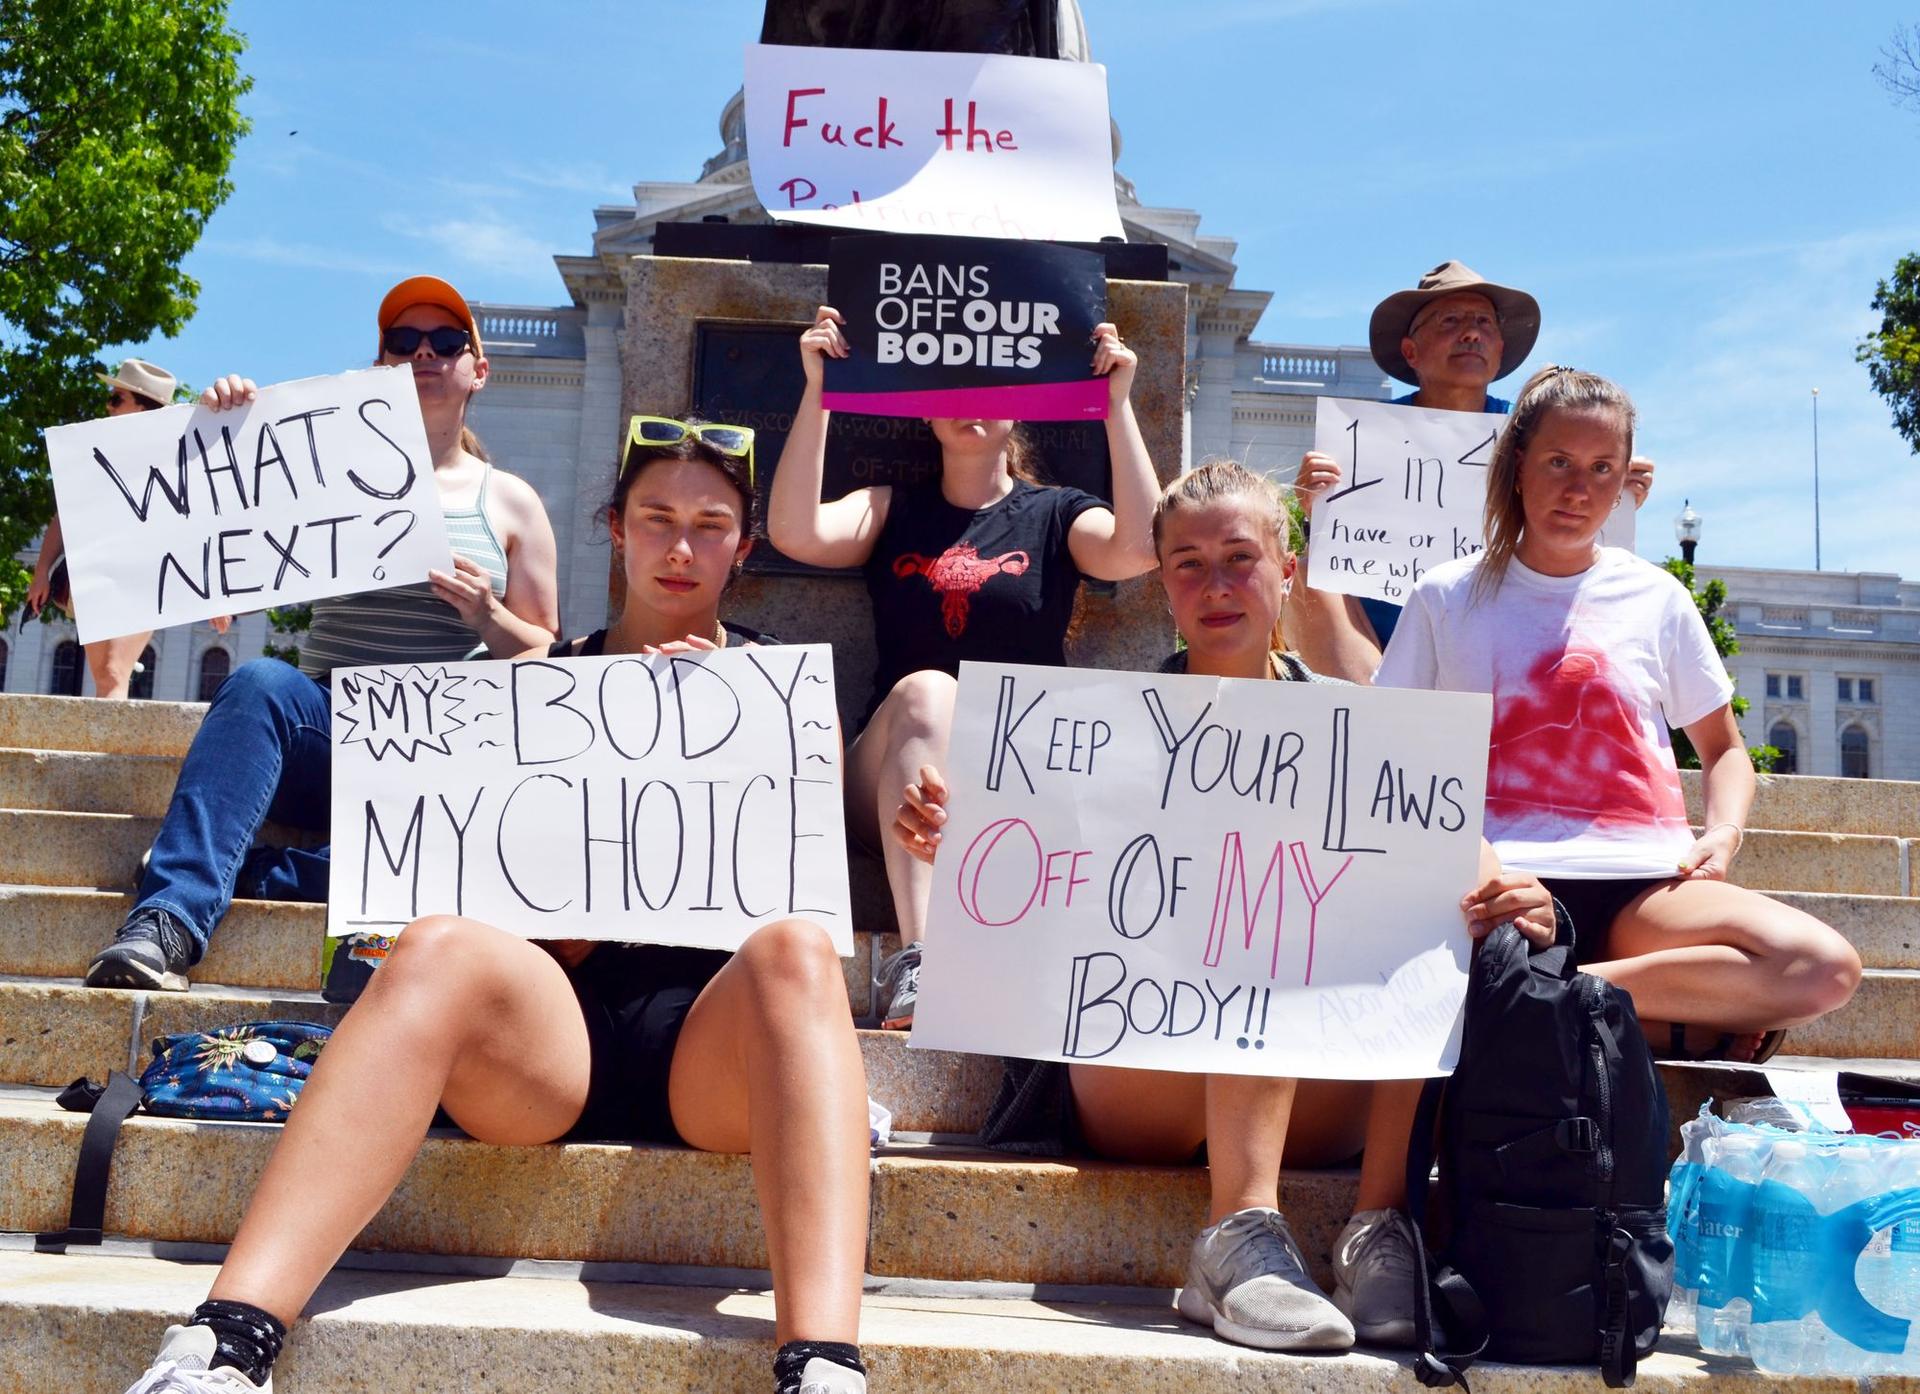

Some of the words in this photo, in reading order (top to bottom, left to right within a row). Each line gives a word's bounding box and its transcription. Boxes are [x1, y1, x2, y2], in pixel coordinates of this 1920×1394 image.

[783, 87, 904, 150] Fuck
[936, 97, 1019, 153] the
[879, 263, 990, 297] BANS
[875, 298, 957, 331] OFF
[962, 300, 1061, 336] OUR
[876, 333, 1042, 369] BODIES
[92, 398, 417, 522] WHATS
[1404, 440, 1444, 508] in
[1331, 518, 1392, 544] have
[1409, 534, 1436, 548] or
[158, 509, 418, 614] NEXT?
[1330, 555, 1382, 576] one
[1389, 557, 1426, 582] wh
[1380, 580, 1402, 597] to
[367, 678, 441, 735] MY
[511, 651, 809, 776] BODY
[361, 786, 485, 918] MY
[496, 773, 837, 918] CHOICE
[957, 818, 1093, 927] OFF
[1108, 834, 1192, 939] OF
[1203, 832, 1354, 986] MY
[1698, 1218, 1743, 1238] ater
